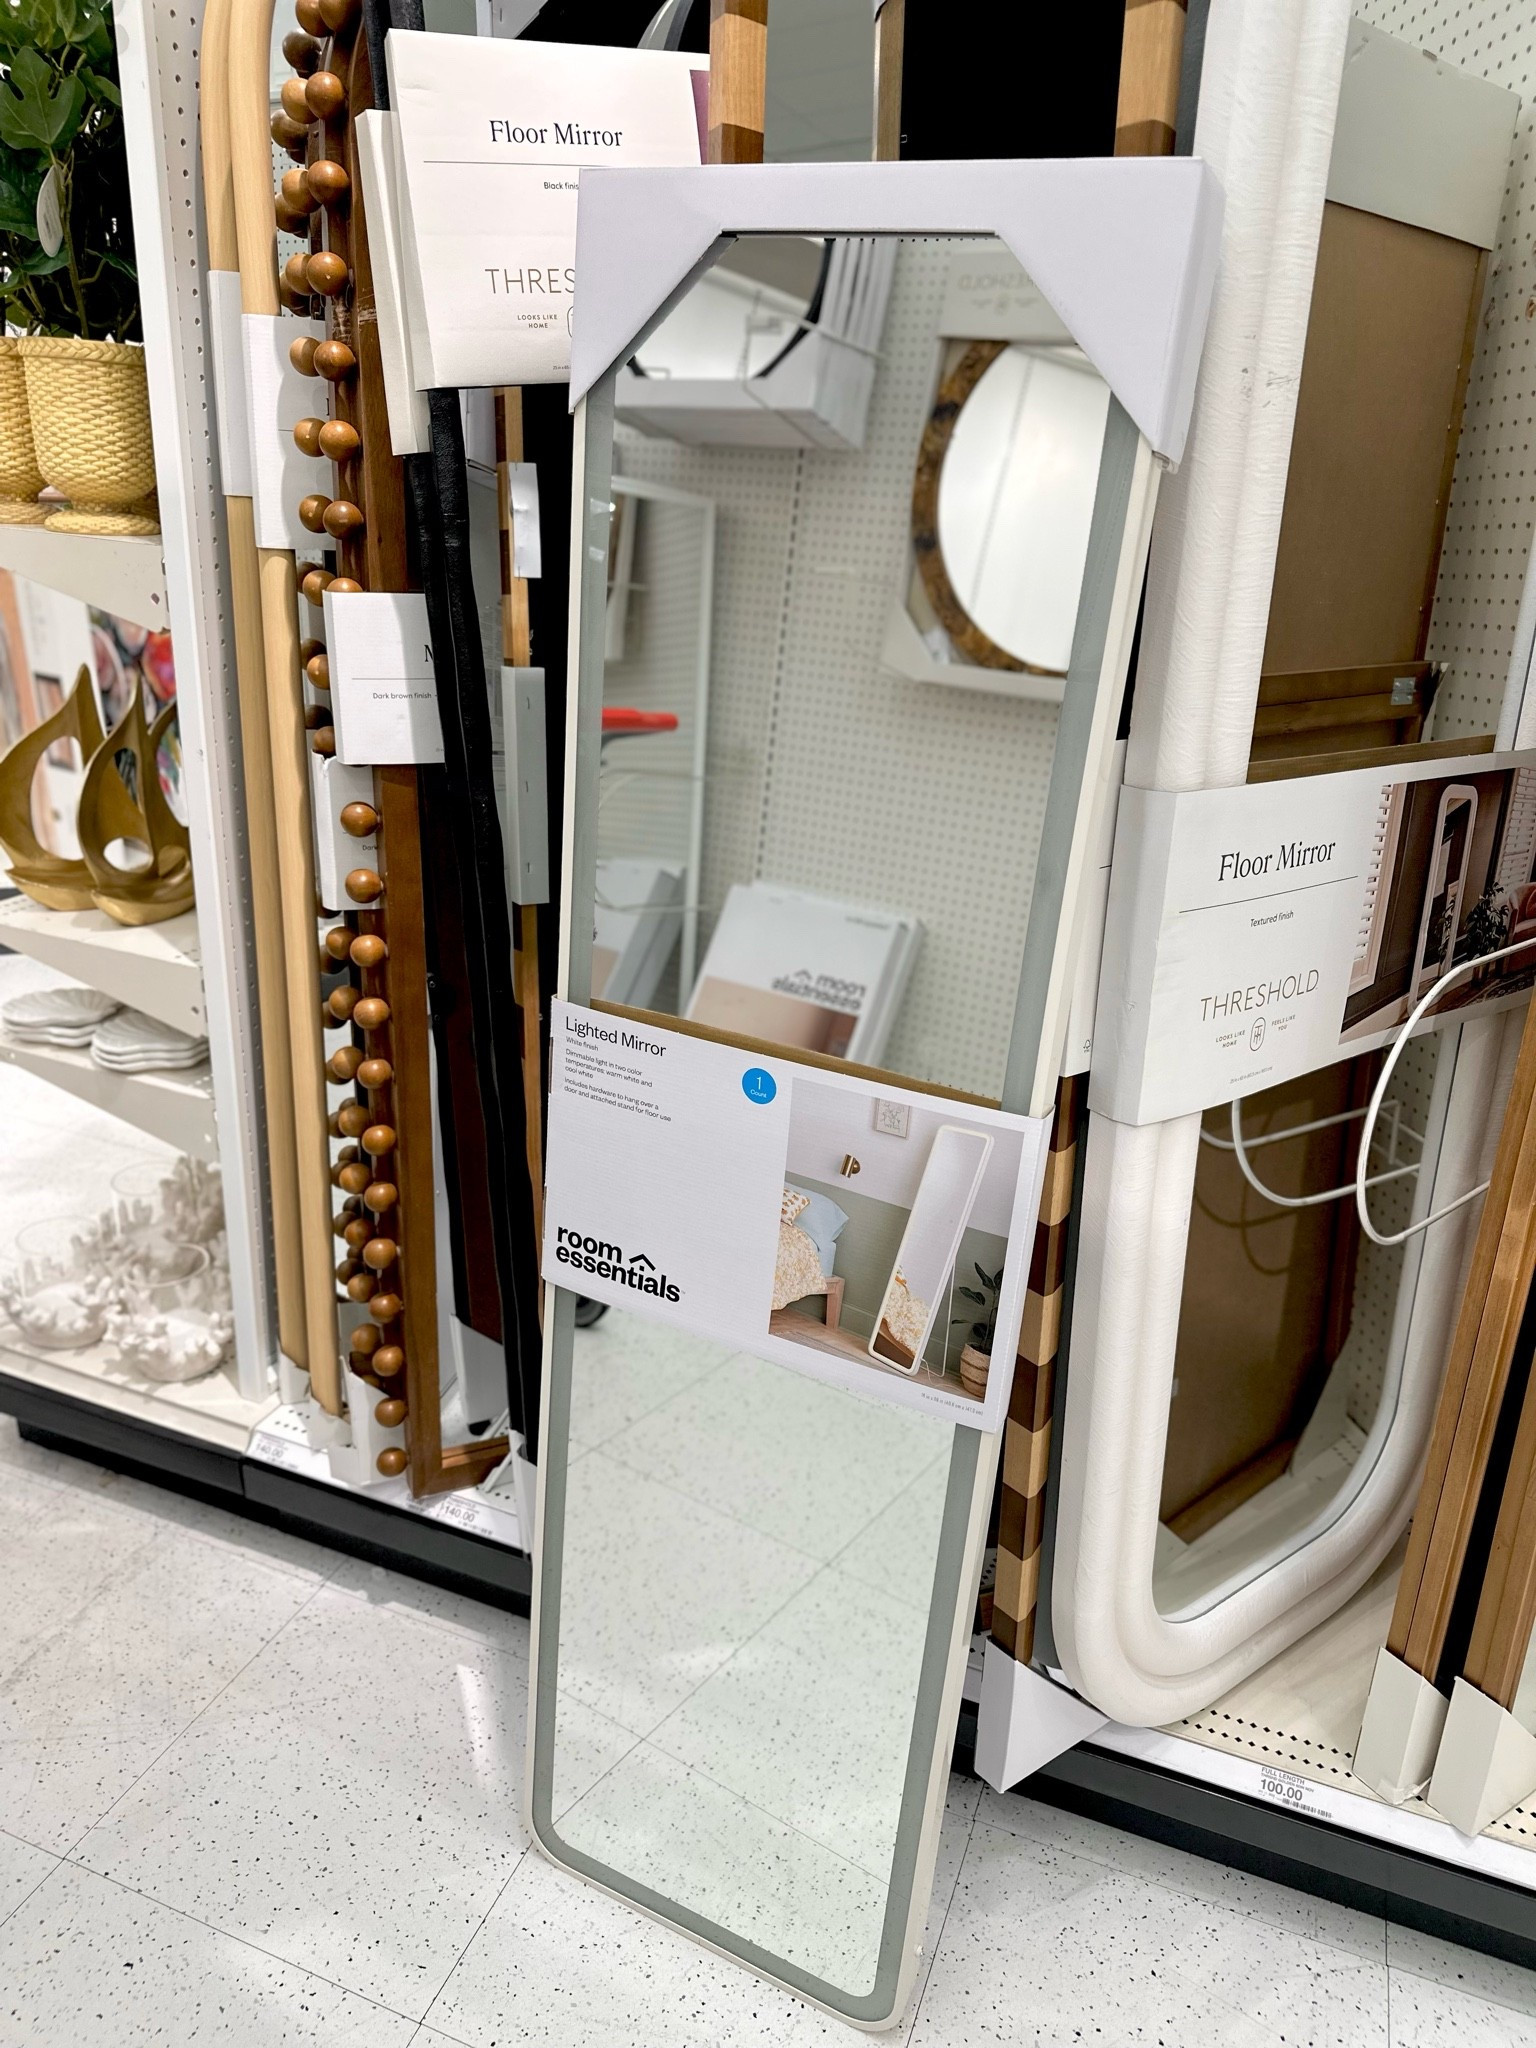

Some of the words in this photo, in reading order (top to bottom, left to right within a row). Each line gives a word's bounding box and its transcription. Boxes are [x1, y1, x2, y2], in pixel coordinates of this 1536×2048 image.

[489, 119, 548, 144] Floor
[553, 122, 623, 147] Mirror
[543, 181, 563, 190] Black
[564, 181, 580, 190] finis
[485, 268, 575, 294] THRES
[1218, 851, 1273, 882] Floor
[1275, 841, 1336, 871] Mirror
[1250, 914, 1278, 928] Textured
[1278, 909, 1294, 922] finish
[1200, 969, 1319, 1022] THRESHOLD
[1271, 1017, 1286, 1027] FEELS
[1285, 1014, 1296, 1022] LIKE
[565, 1015, 618, 1044] Lighted
[621, 1032, 667, 1057] Mirror
[565, 1035, 582, 1047] White
[583, 1041, 599, 1052] finish
[1215, 1033, 1234, 1043] LOOKS
[1234, 1029, 1246, 1038] LIKE
[1222, 1039, 1237, 1048] HOME
[565, 1048, 595, 1063] Dimmable
[595, 1057, 608, 1067] light
[614, 1064, 627, 1072] two
[627, 1067, 643, 1076] color
[565, 1065, 578, 1074] cool
[578, 1069, 594, 1079] white
[565, 1057, 605, 1074] temperatures:
[606, 1070, 623, 1079] warm
[623, 1075, 640, 1084] white
[640, 1080, 653, 1088] and
[564, 1076, 588, 1090] Includes
[588, 1083, 617, 1098] hardware
[624, 1094, 640, 1105] hang
[640, 1100, 654, 1108] over
[750, 1088, 767, 1099] Count
[756, 1076, 762, 1090] 1
[564, 1085, 578, 1094] door
[578, 1090, 590, 1098] and
[590, 1093, 617, 1106] attached
[617, 1101, 635, 1112] stand
[635, 1106, 644, 1114] for
[644, 1109, 659, 1118] floor
[660, 1114, 671, 1122] use
[557, 1226, 623, 1264] room
[556, 1245, 681, 1303] essentials
[444, 1505, 475, 1522] 140.00
[1261, 1766, 1278, 1776] FULL
[1278, 1772, 1305, 1785] LENGTH
[1260, 1778, 1303, 1801] 100.00
